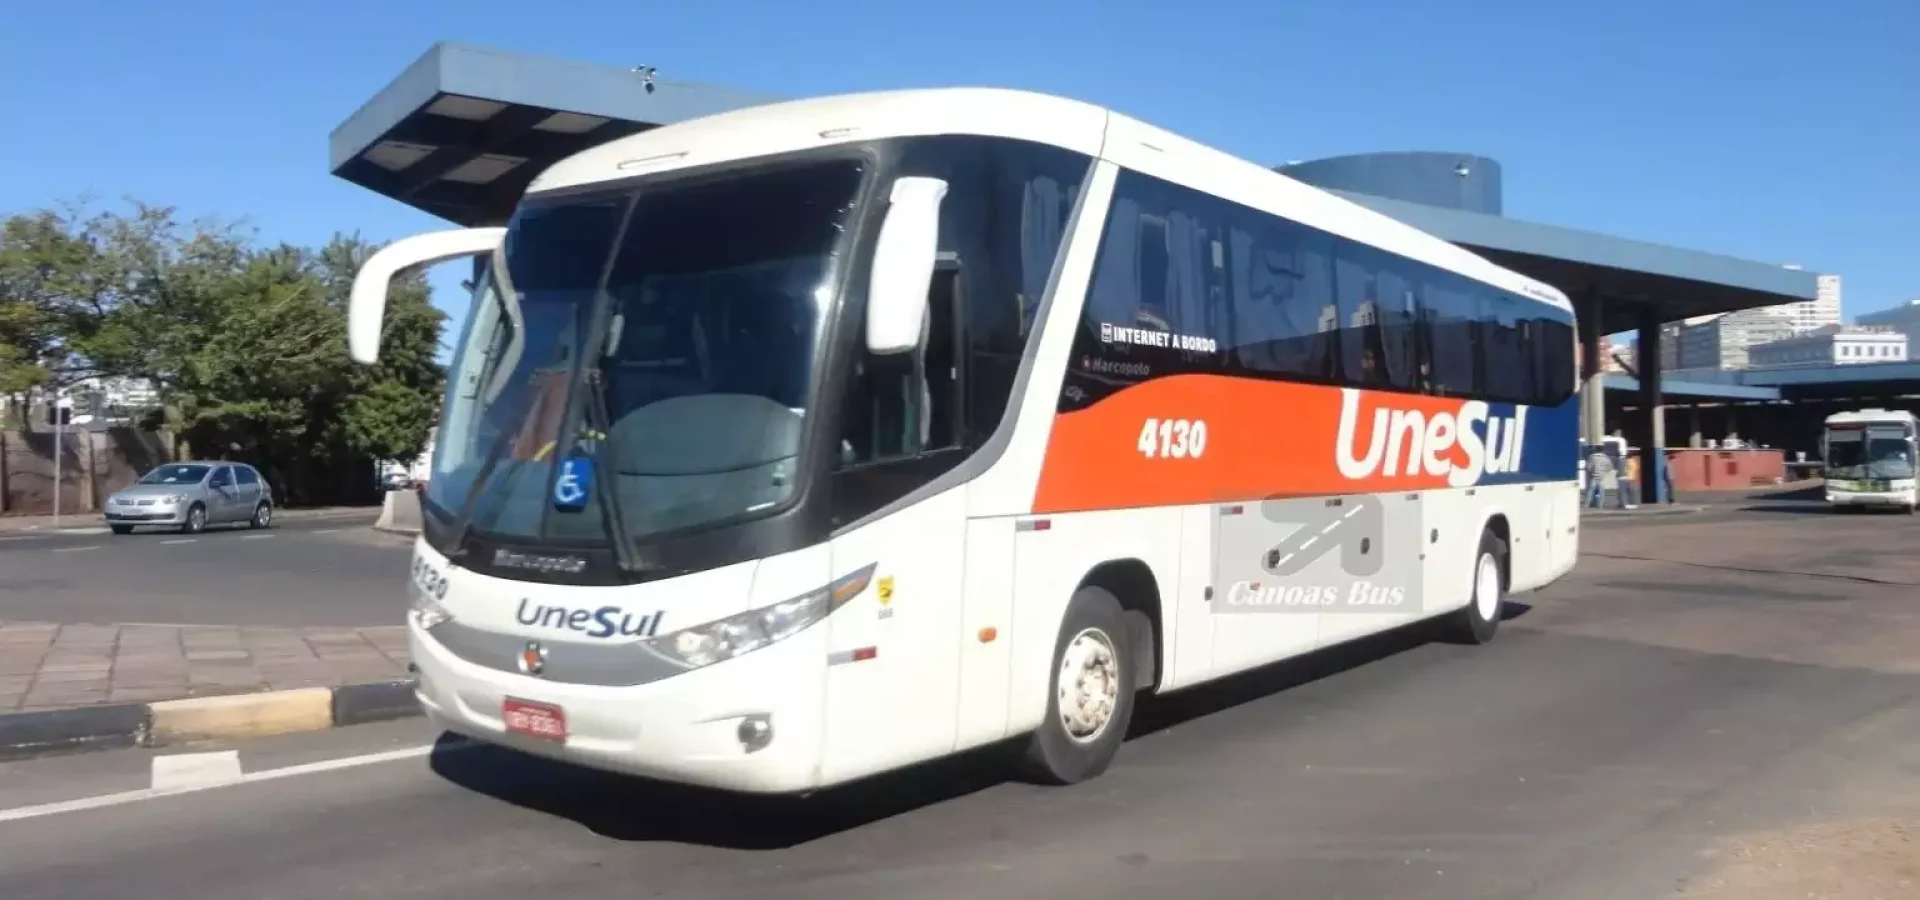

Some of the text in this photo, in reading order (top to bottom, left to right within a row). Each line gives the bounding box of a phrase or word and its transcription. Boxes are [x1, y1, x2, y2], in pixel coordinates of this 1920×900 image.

[1113, 326, 1217, 352] INTERNET A BORDO
[1137, 418, 1207, 458] 4130
[1335, 387, 1530, 487] UneSul
[515, 598, 666, 638] UneSul
